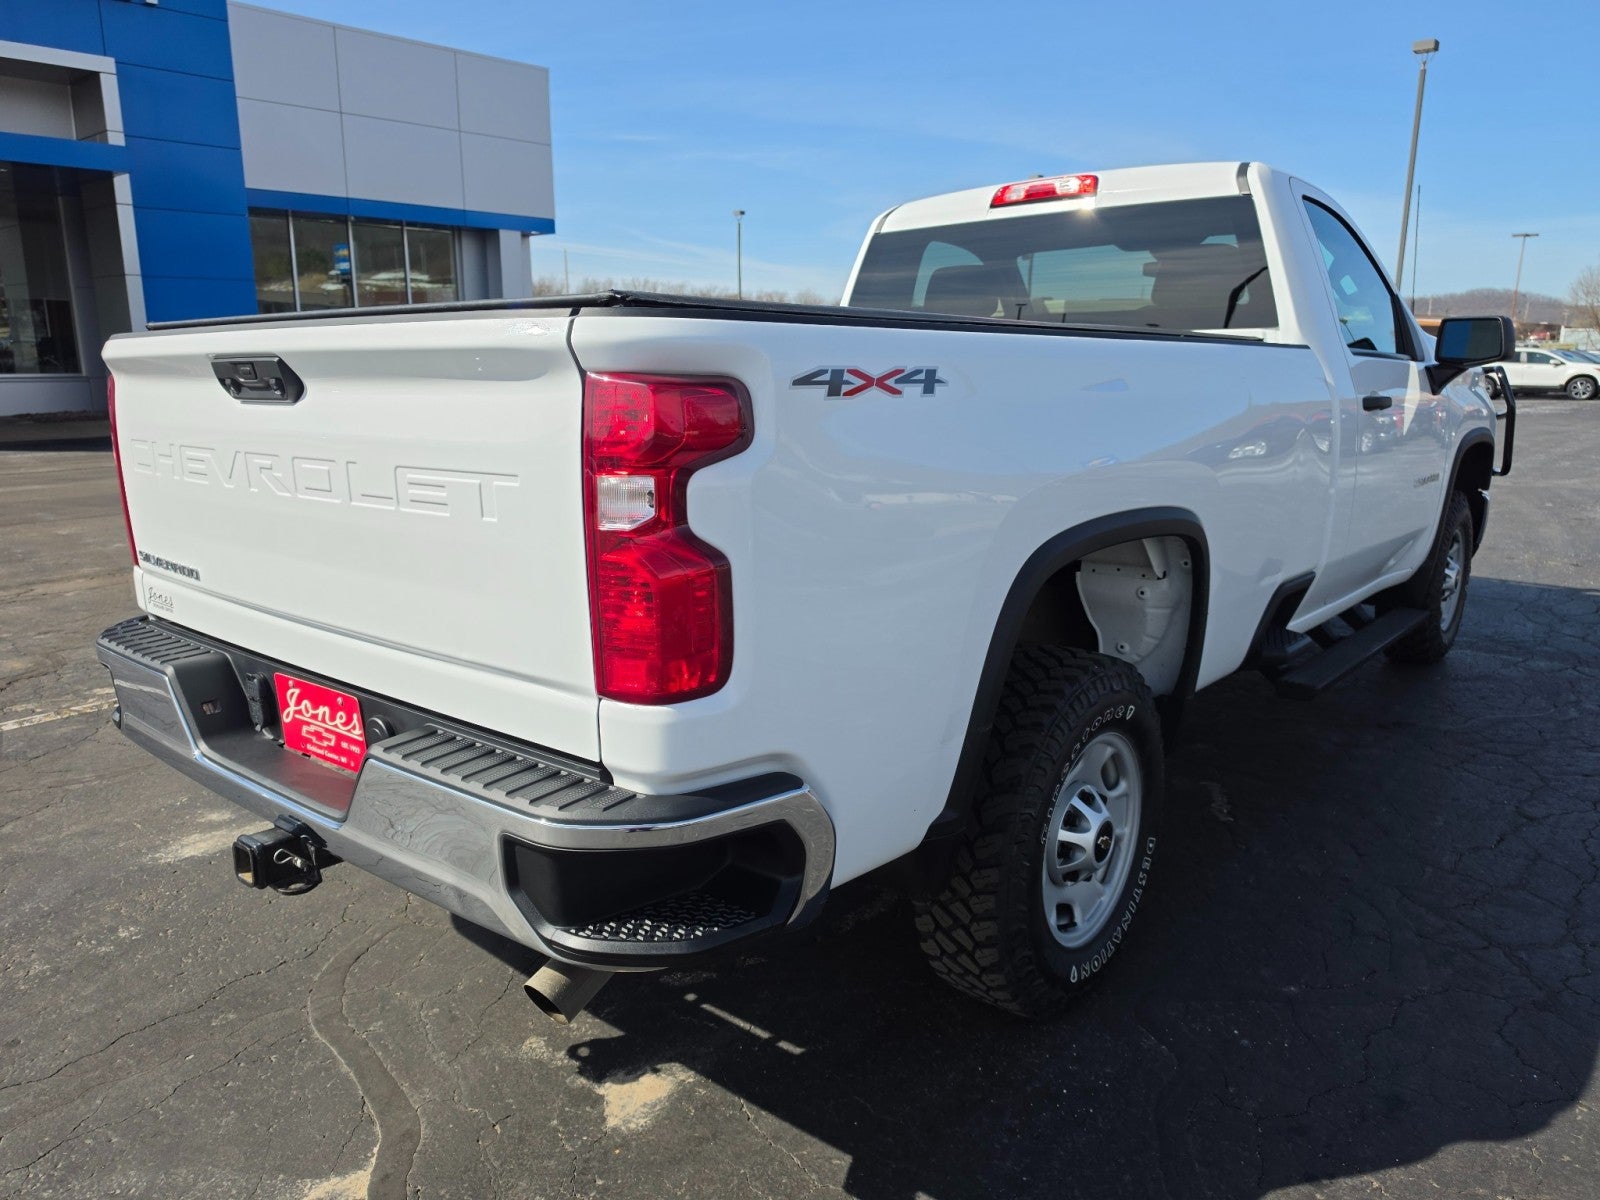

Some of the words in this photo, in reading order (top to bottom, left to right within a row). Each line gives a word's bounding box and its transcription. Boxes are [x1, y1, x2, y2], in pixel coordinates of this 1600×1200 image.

[790, 366, 948, 399] 4X4
[130, 438, 520, 522] CHEVROLET
[283, 688, 362, 735] Jones
[1080, 837, 1156, 980] DESTINATION
